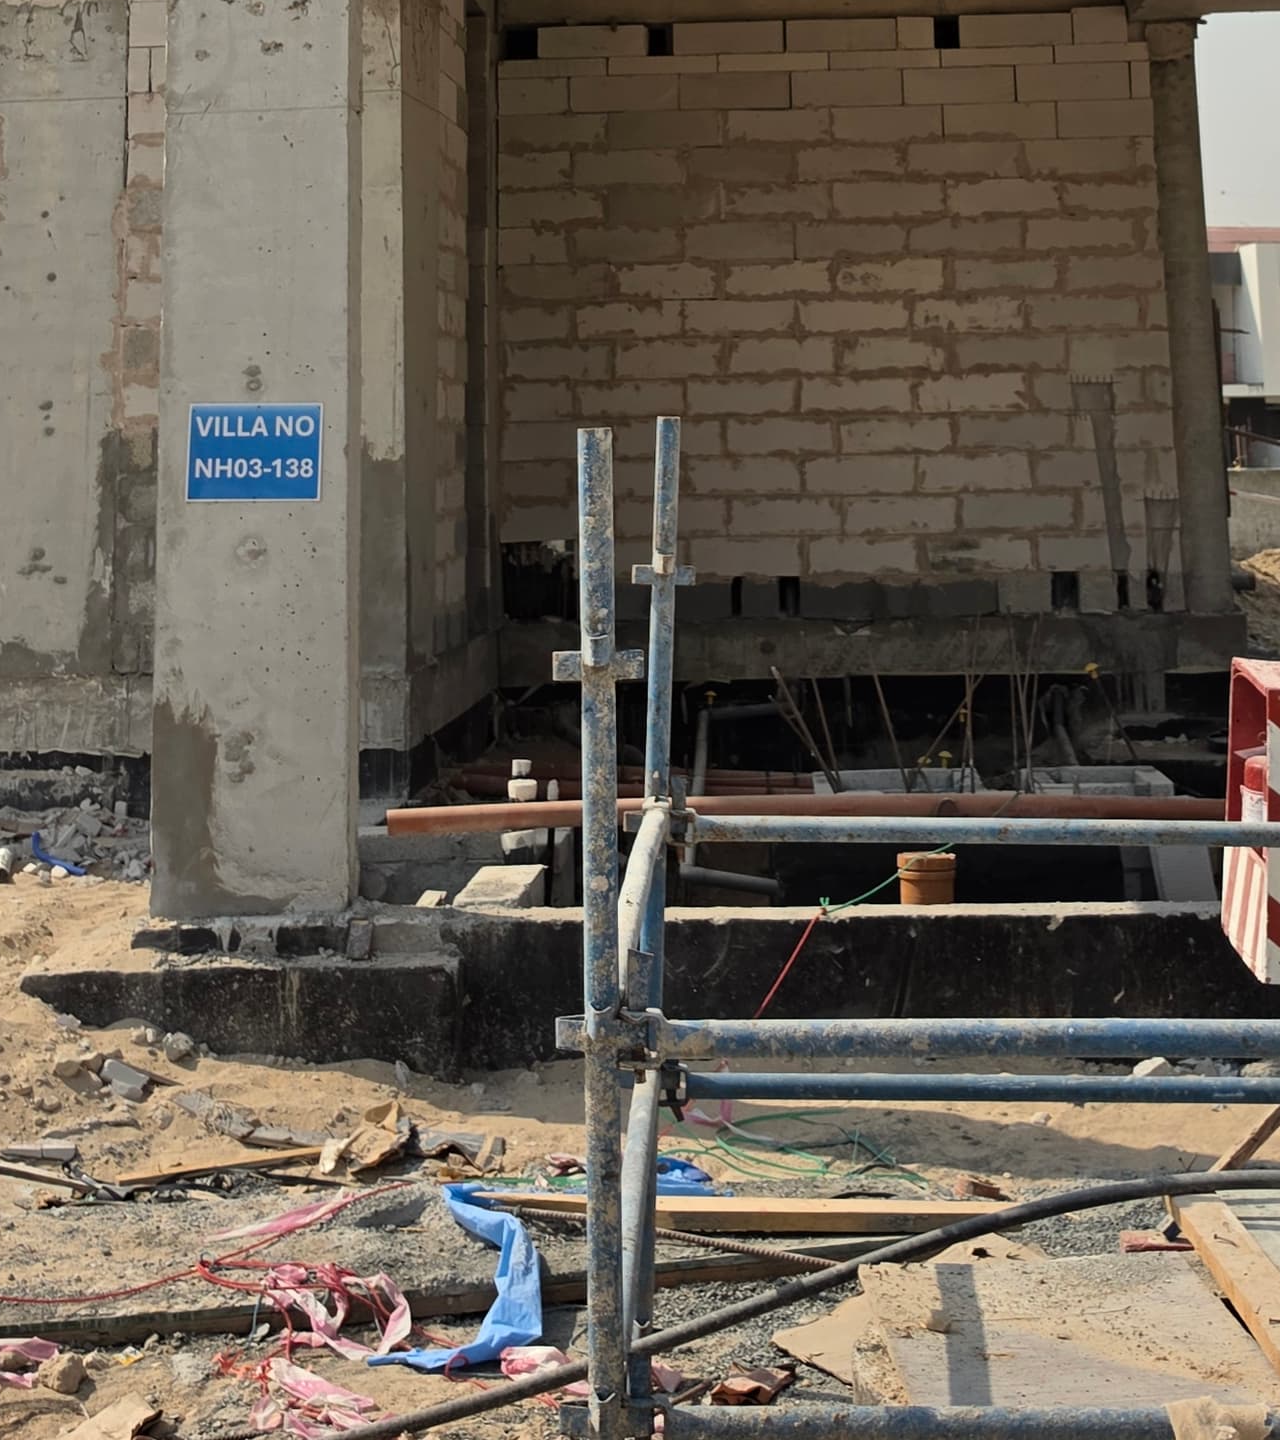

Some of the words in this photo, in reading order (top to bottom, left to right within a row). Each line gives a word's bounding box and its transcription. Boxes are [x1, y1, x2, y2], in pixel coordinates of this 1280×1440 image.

[196, 415, 269, 437] VILLA
[275, 415, 315, 437] NO
[194, 458, 314, 479] NH03-138
